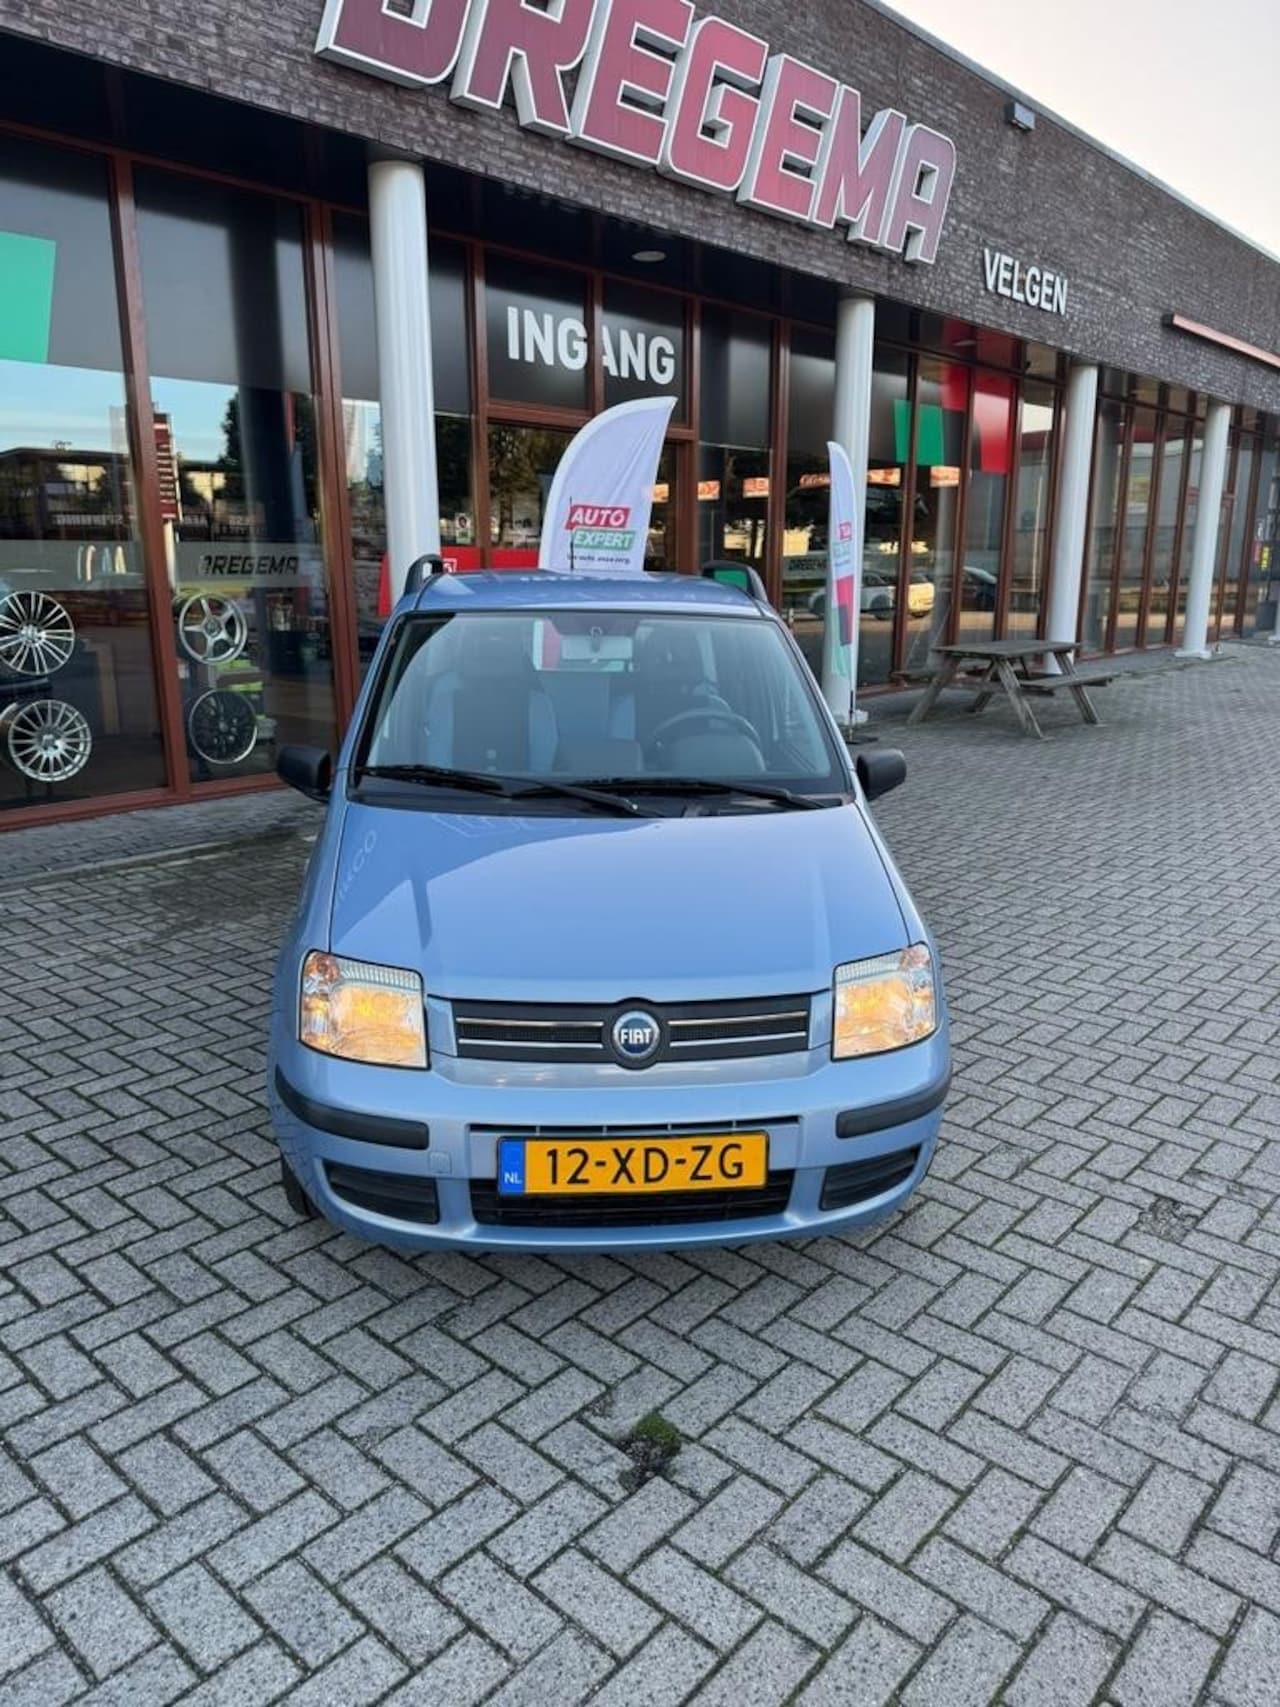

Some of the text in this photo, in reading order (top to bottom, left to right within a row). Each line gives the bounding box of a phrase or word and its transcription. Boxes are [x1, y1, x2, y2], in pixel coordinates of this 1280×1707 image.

[984, 247, 1068, 316] VELGEN
[507, 306, 675, 385] INGANG
[571, 507, 625, 526] AUTO
[574, 530, 634, 548] EXPERT
[621, 1028, 652, 1045] FIAT
[504, 1143, 744, 1185] NL 12-XD-ZG
